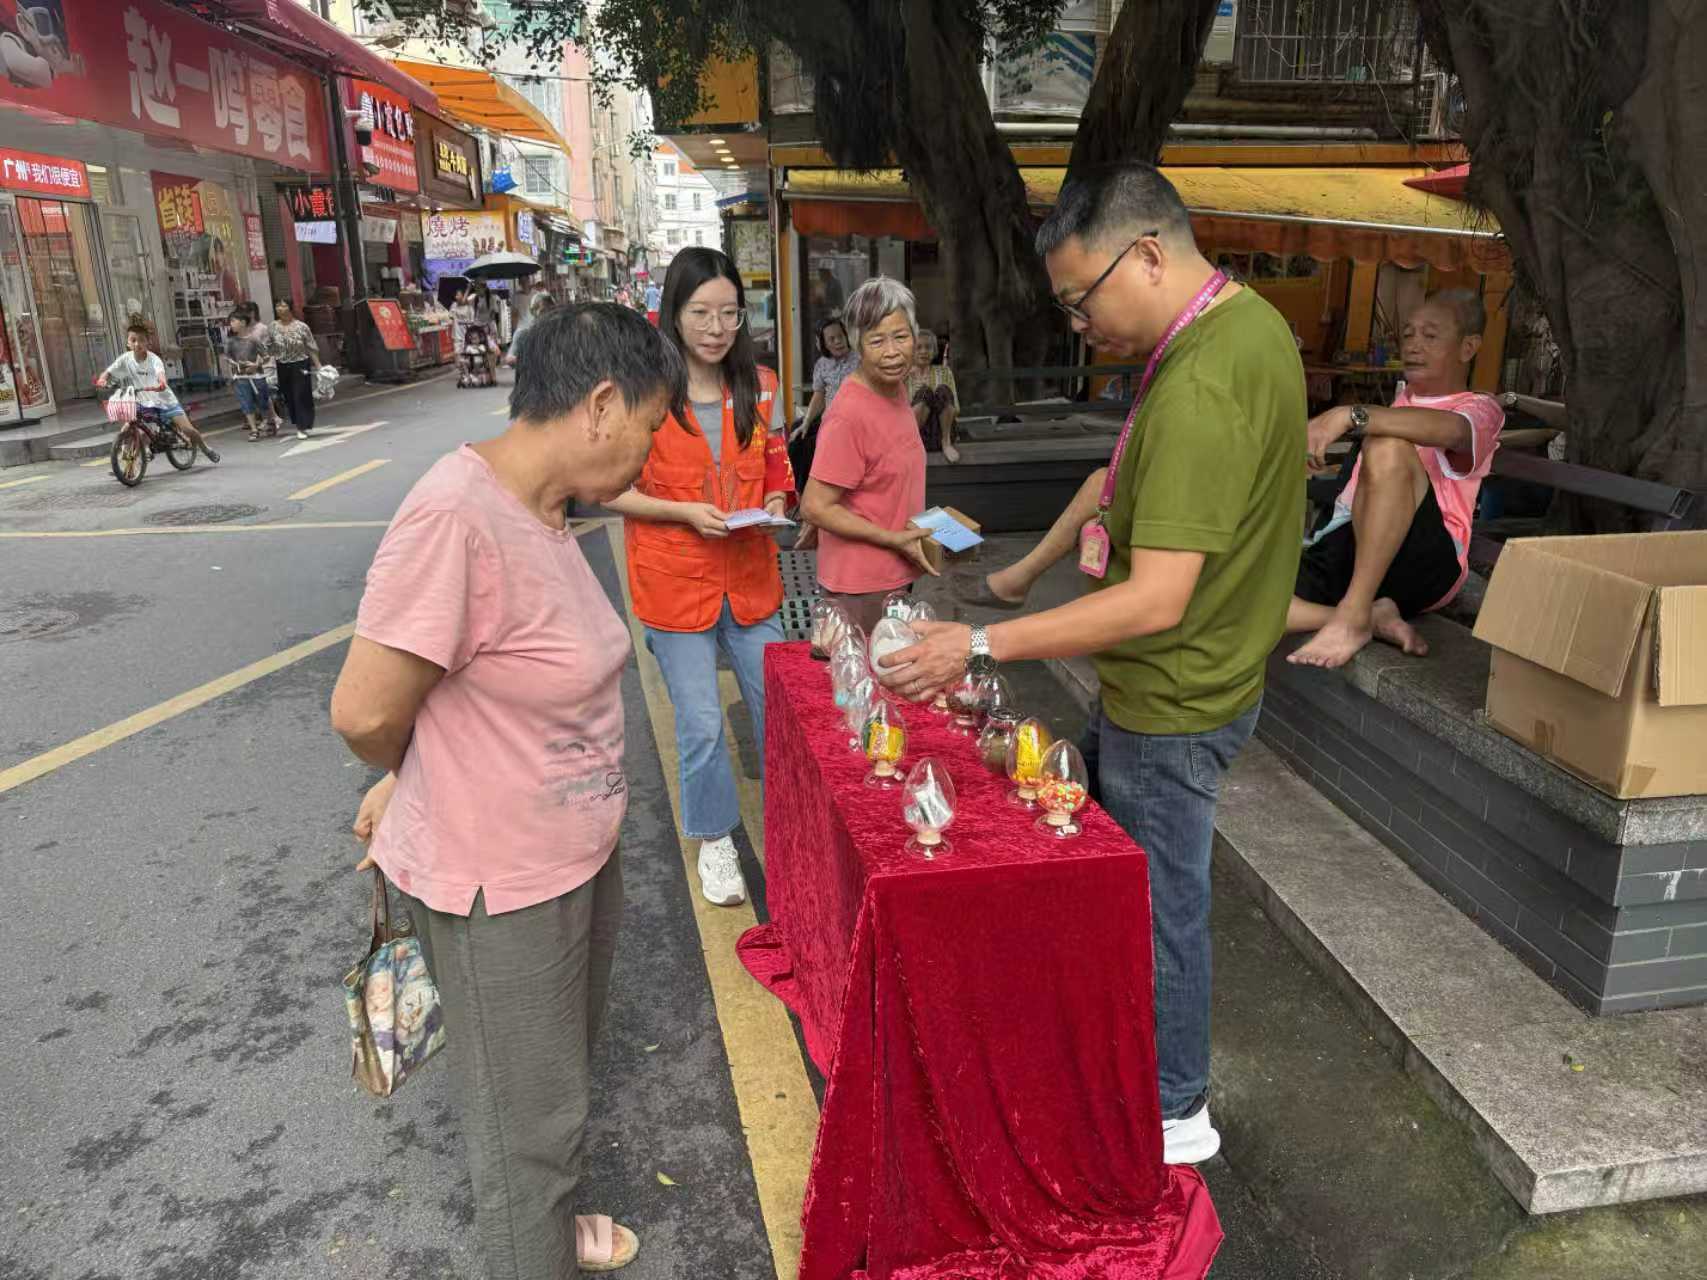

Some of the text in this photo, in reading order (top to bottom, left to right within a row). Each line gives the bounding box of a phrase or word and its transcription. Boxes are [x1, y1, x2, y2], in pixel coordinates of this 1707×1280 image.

[123, 6, 310, 161] 赵一鸣零食
